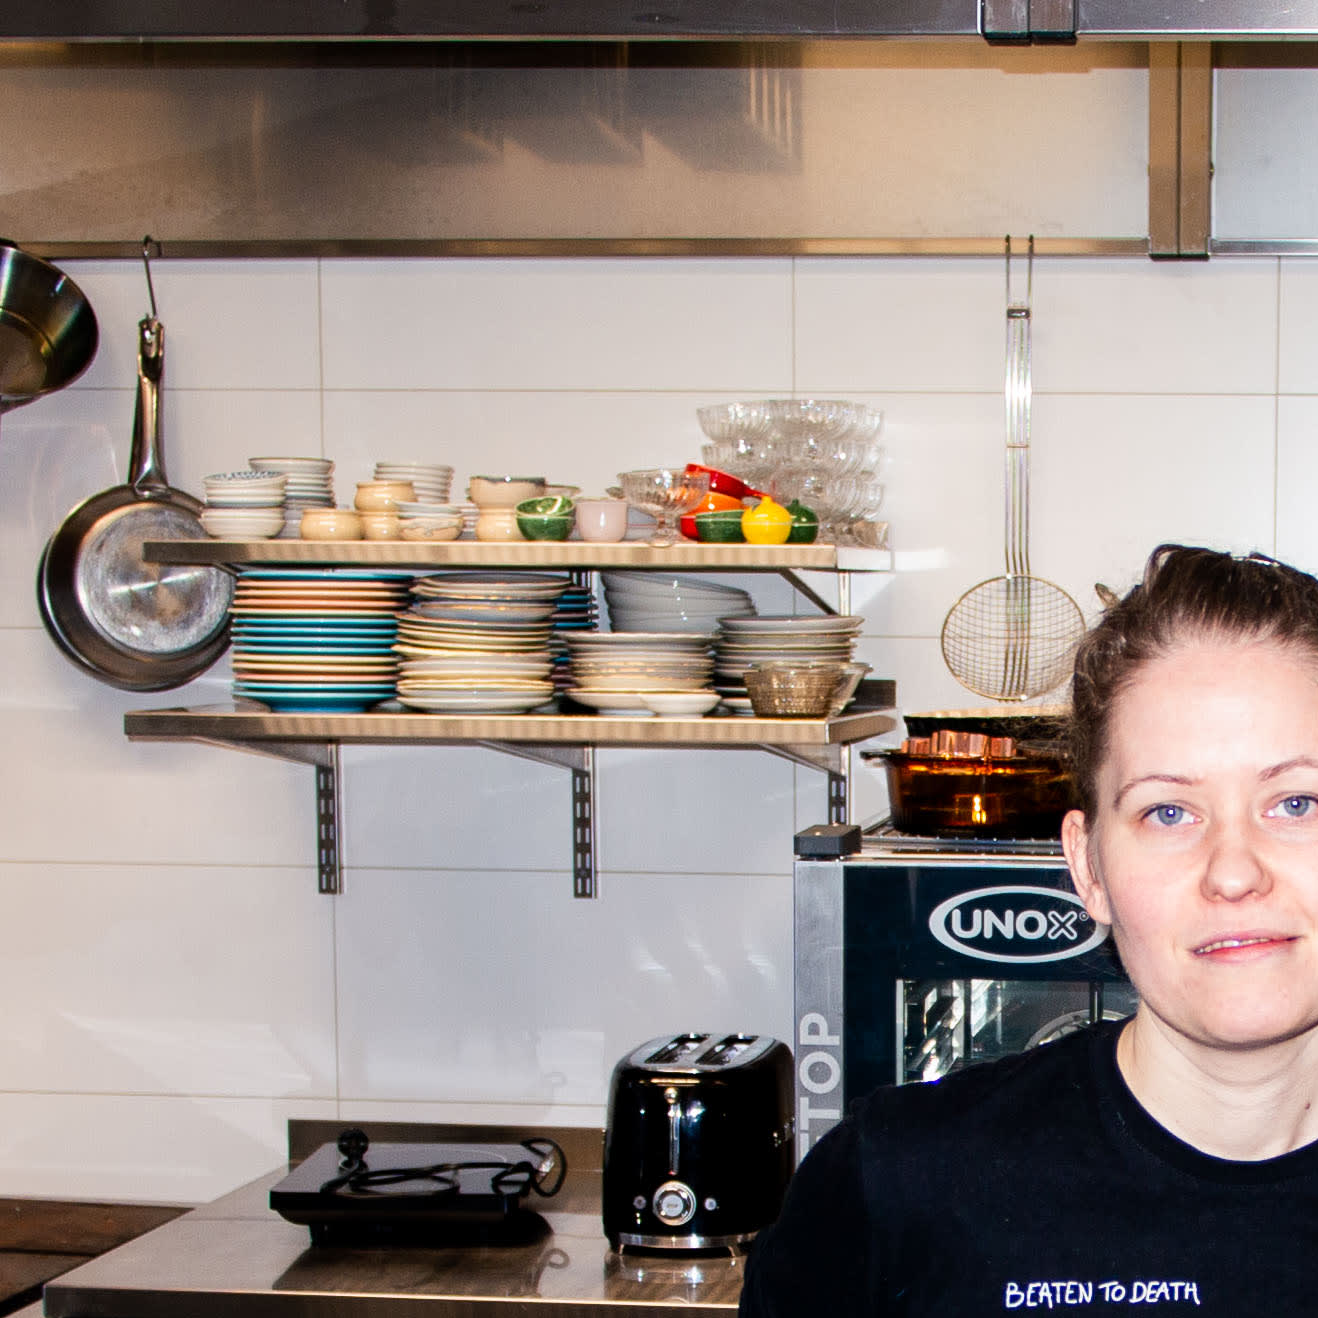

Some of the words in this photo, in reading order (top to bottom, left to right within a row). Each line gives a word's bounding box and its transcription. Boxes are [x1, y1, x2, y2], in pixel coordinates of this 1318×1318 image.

[1005, 1281, 1093, 1309] BEATEN
[1098, 1281, 1126, 1302] TO
[1129, 1281, 1201, 1305] DEATH
